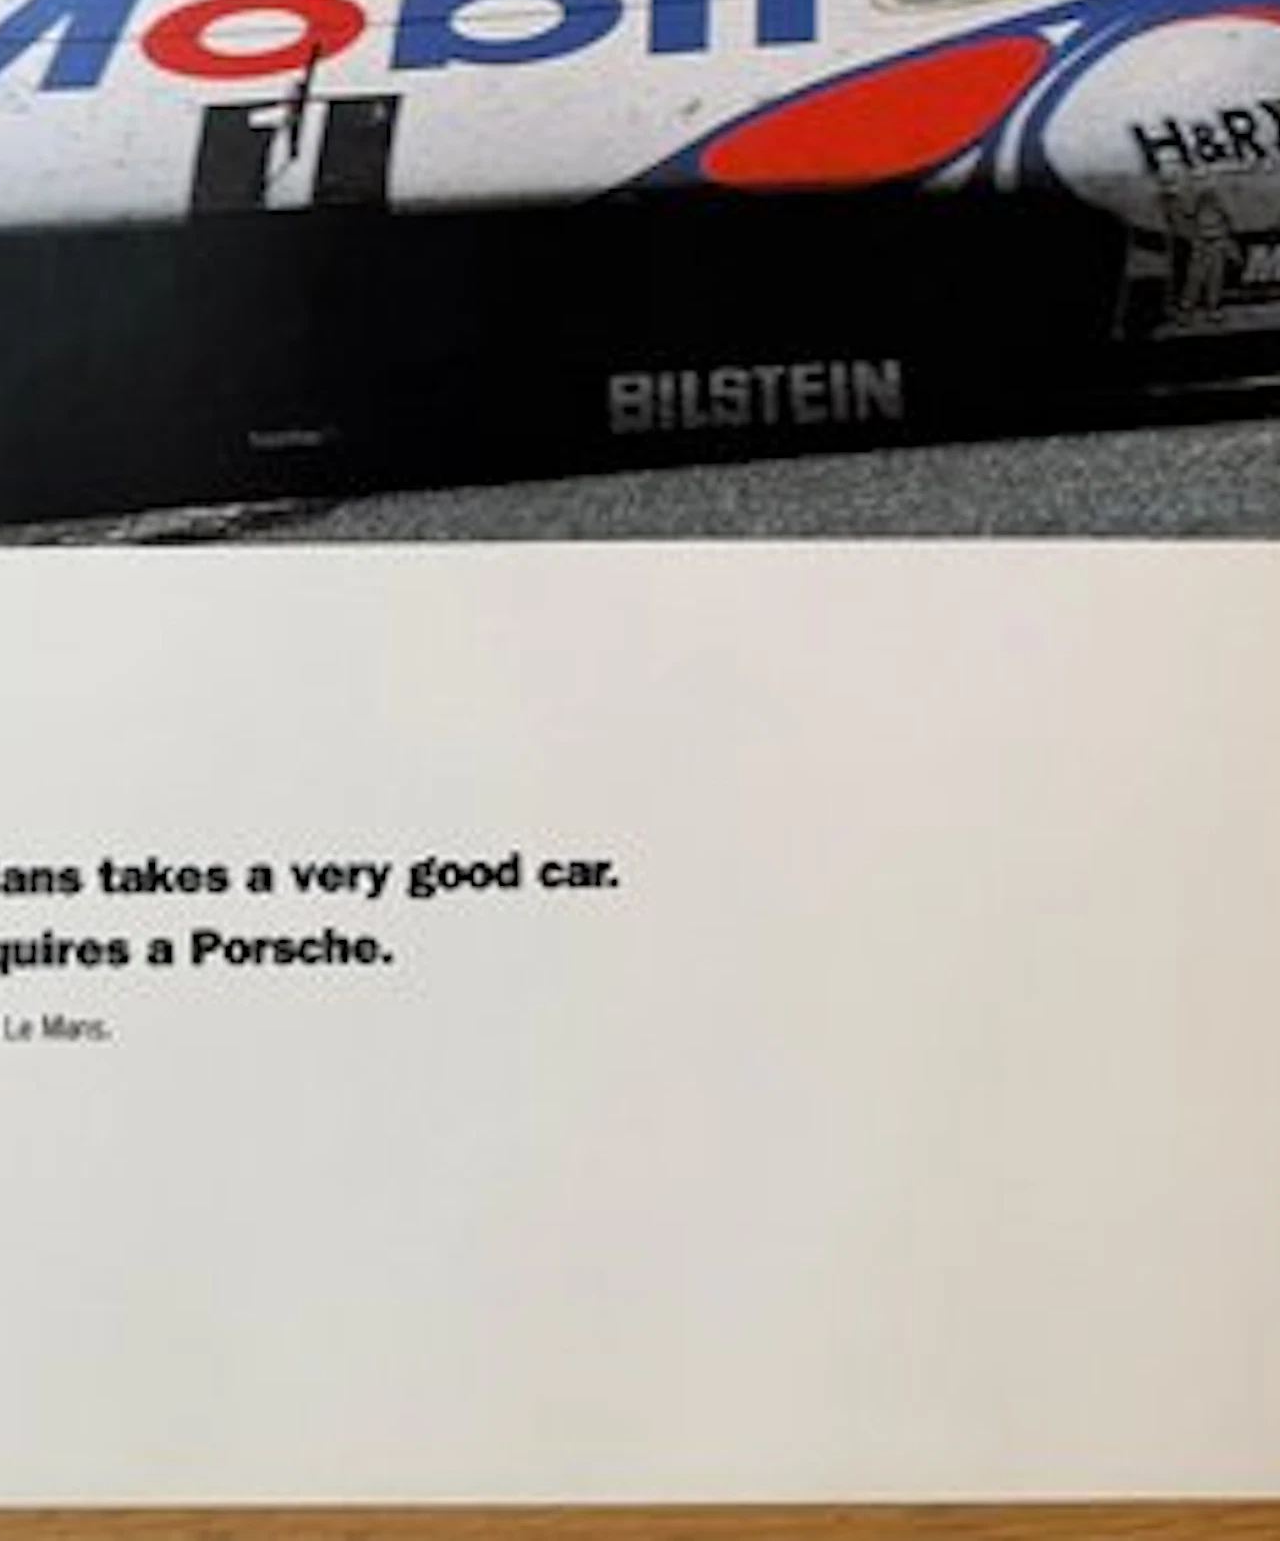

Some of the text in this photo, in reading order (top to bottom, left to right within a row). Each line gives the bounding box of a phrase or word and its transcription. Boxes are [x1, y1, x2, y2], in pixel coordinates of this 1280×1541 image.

[1131, 107, 1266, 174] H&R
[608, 358, 904, 435] BILSTEIN
[98, 857, 231, 895] takes
[246, 864, 274, 893] a
[290, 863, 391, 899] very
[406, 853, 522, 899] good
[537, 861, 619, 890] car.
[147, 938, 174, 966] a
[191, 928, 393, 966] Porsche.
[3, 1014, 34, 1043] Le
[40, 1014, 111, 1043] Mans.
